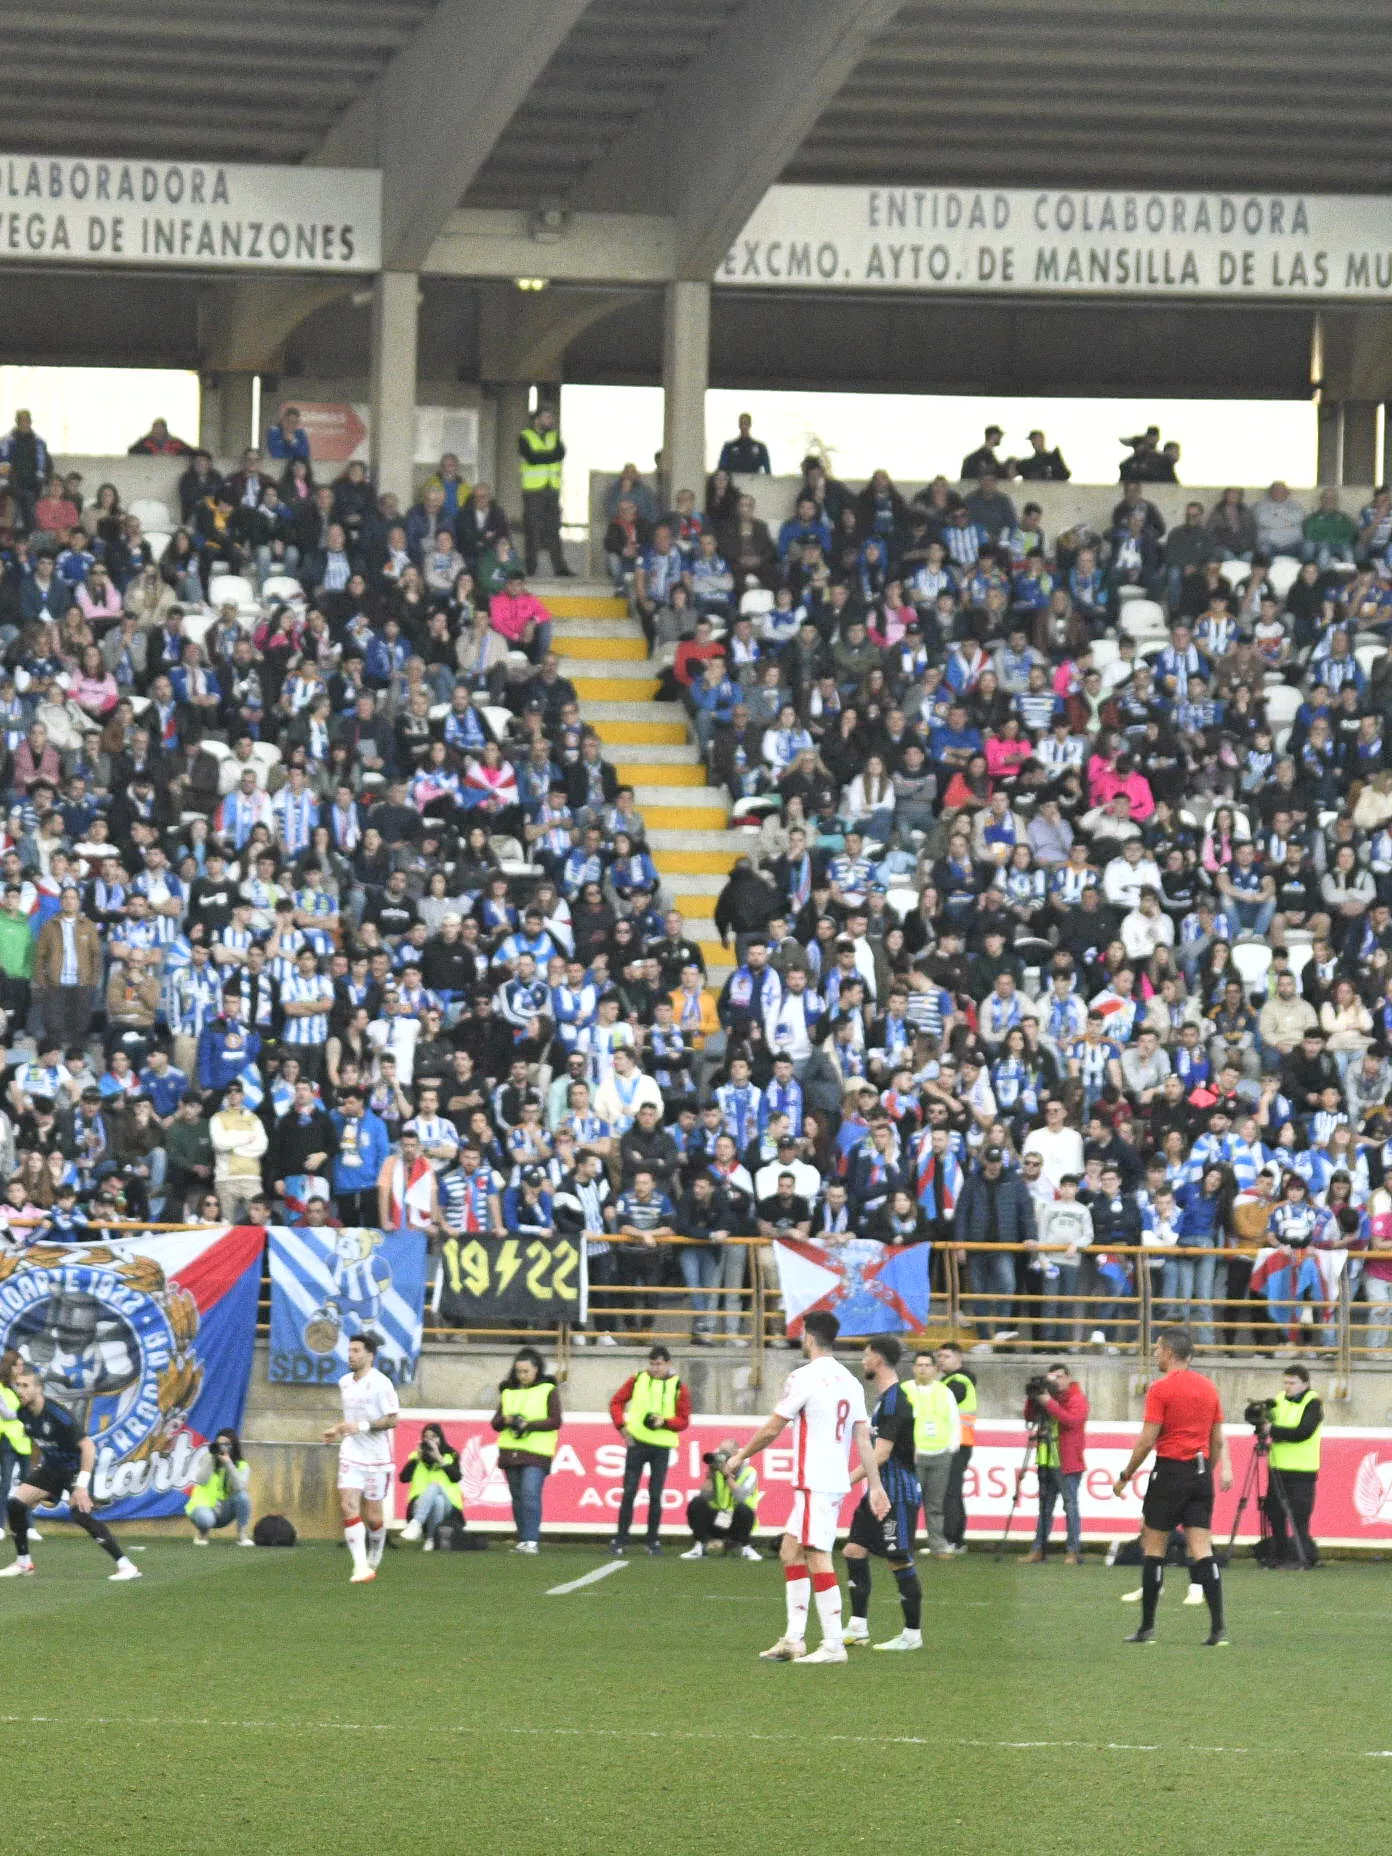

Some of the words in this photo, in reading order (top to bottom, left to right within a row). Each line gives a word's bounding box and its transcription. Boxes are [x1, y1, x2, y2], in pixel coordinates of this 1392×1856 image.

[868, 191, 1010, 230] ENTIDAD
[1033, 193, 1308, 235] COLABORADORA
[88, 215, 125, 252] DE
[142, 217, 356, 262] INFANZONES
[866, 245, 962, 281] AYTO.
[978, 246, 1014, 282] DE
[1035, 247, 1199, 286] MANSILLA
[1218, 249, 1254, 286] DE
[1271, 250, 1328, 288] LAS
[442, 1238, 489, 1297] 19
[526, 1239, 579, 1300] 22
[835, 1399, 850, 1442] 8
